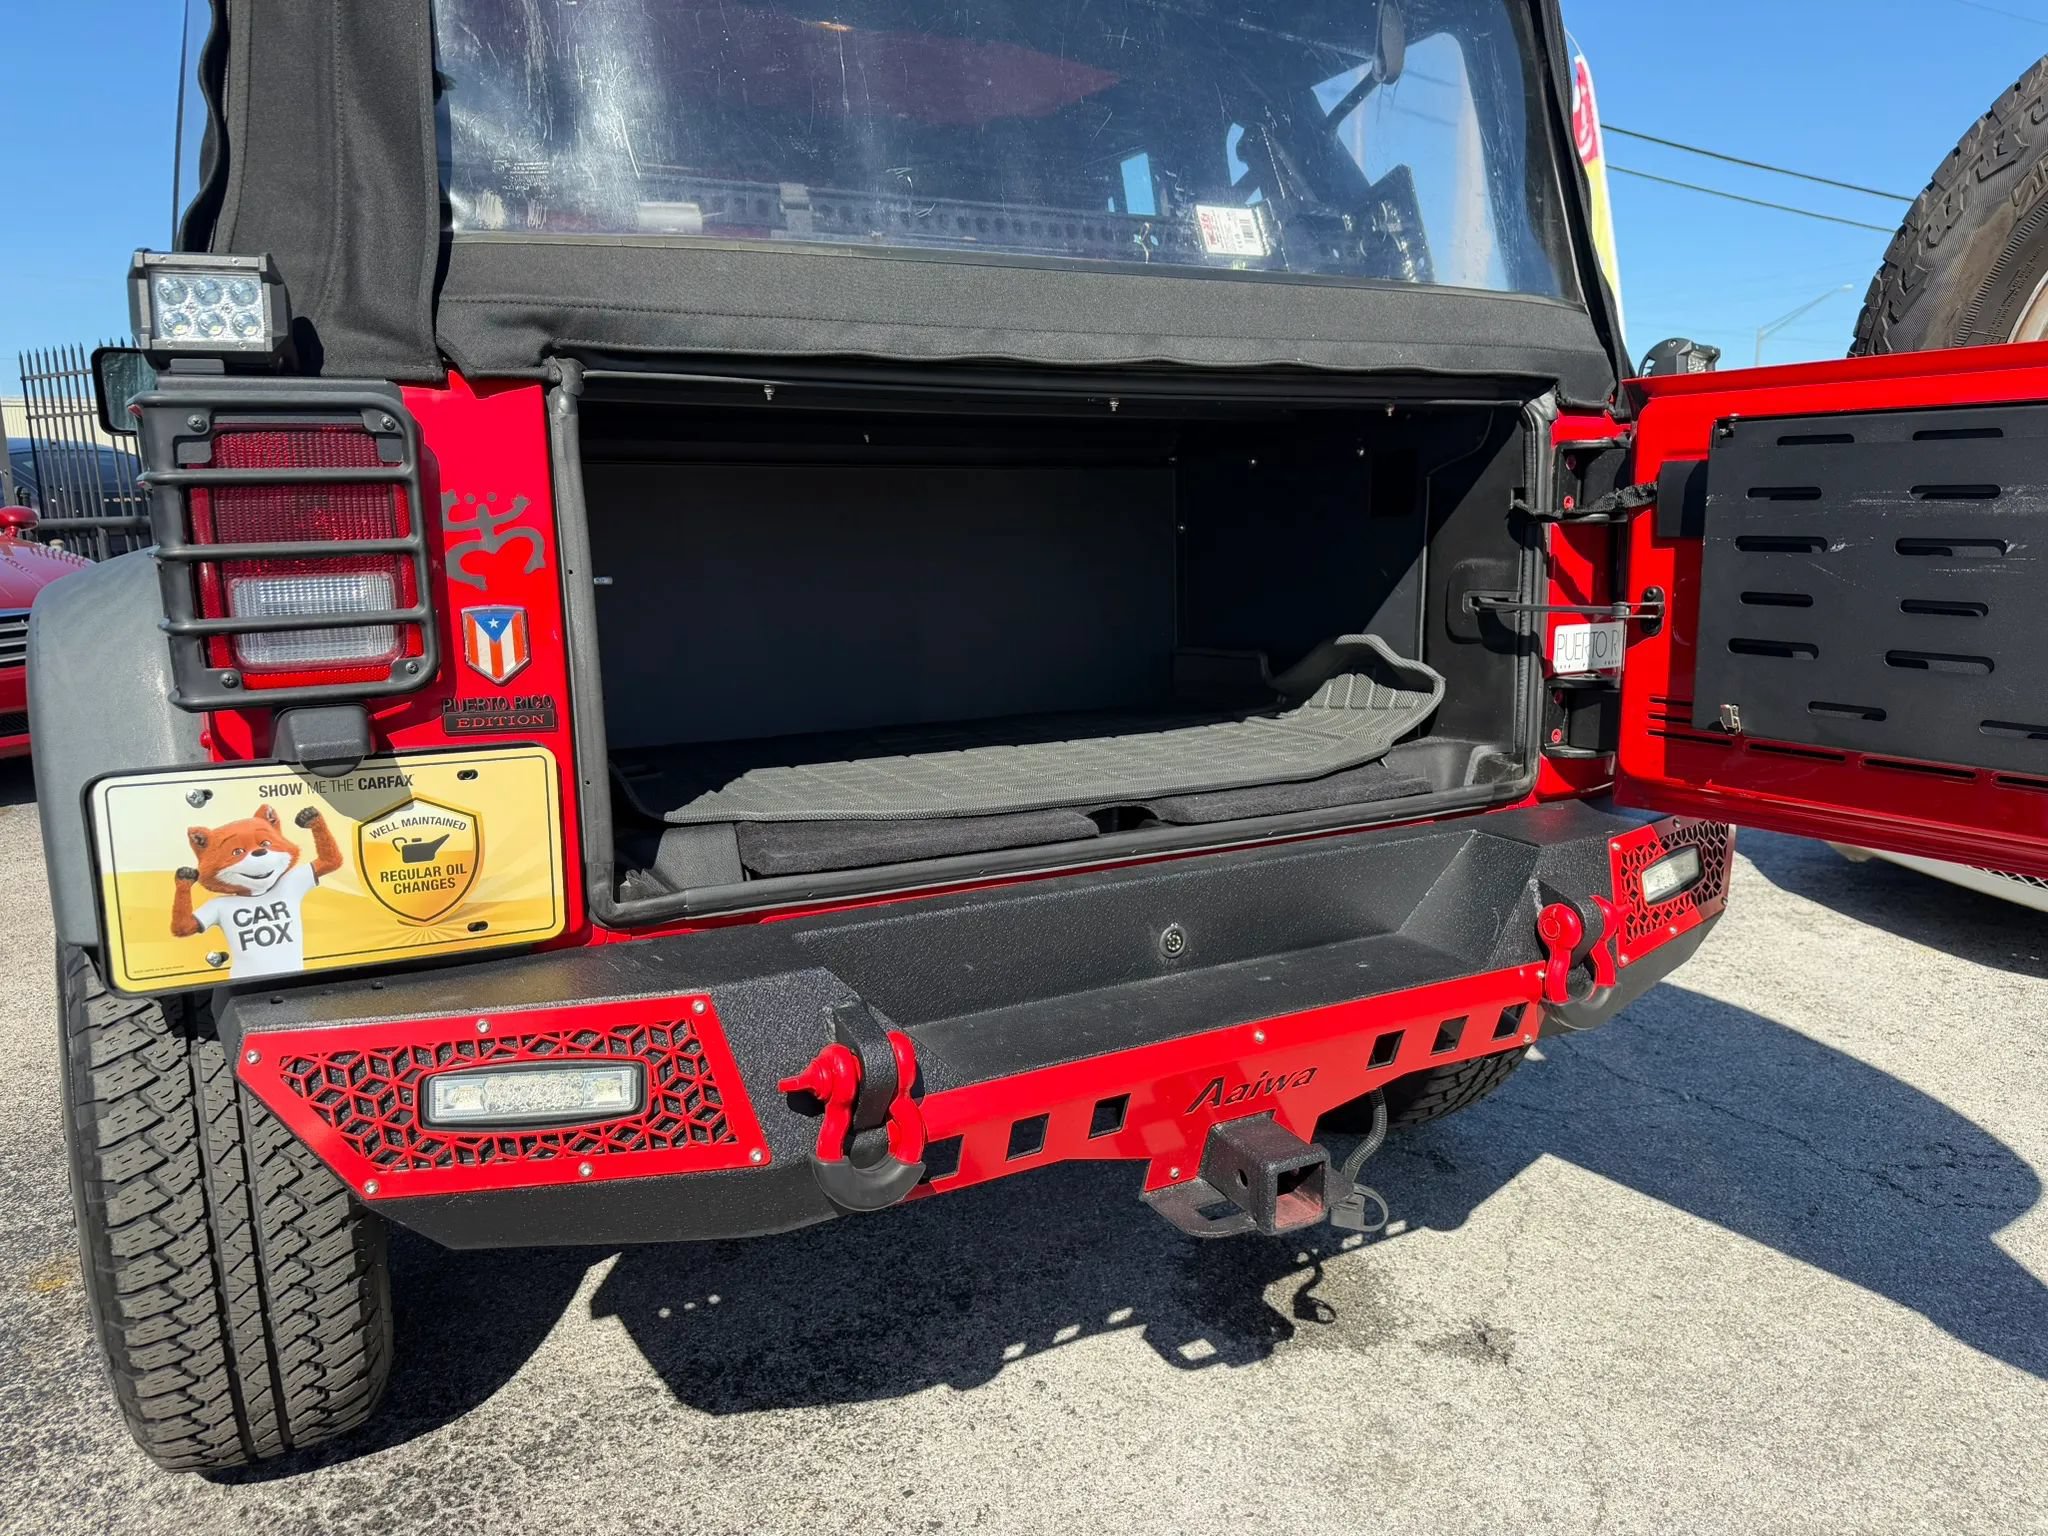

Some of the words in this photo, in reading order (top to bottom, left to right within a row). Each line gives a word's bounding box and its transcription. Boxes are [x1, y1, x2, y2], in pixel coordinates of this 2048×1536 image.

[1556, 630, 1608, 661] PUERTO
[443, 696, 508, 713] PUERTO
[513, 694, 553, 711] RICO
[456, 713, 545, 728] EDITION
[258, 782, 303, 798] SHOW
[307, 780, 327, 794] ME
[329, 778, 354, 792] THE
[358, 774, 413, 791] CARFAX
[369, 822, 399, 839] WELL
[401, 816, 467, 831] MAINTAINED
[380, 865, 441, 883] REGULAR
[446, 863, 467, 876] OIL
[393, 877, 456, 894] CHANGES
[233, 901, 291, 927] CAR
[238, 922, 294, 951] FOX
[1184, 1066, 1318, 1115] Aaiwa
